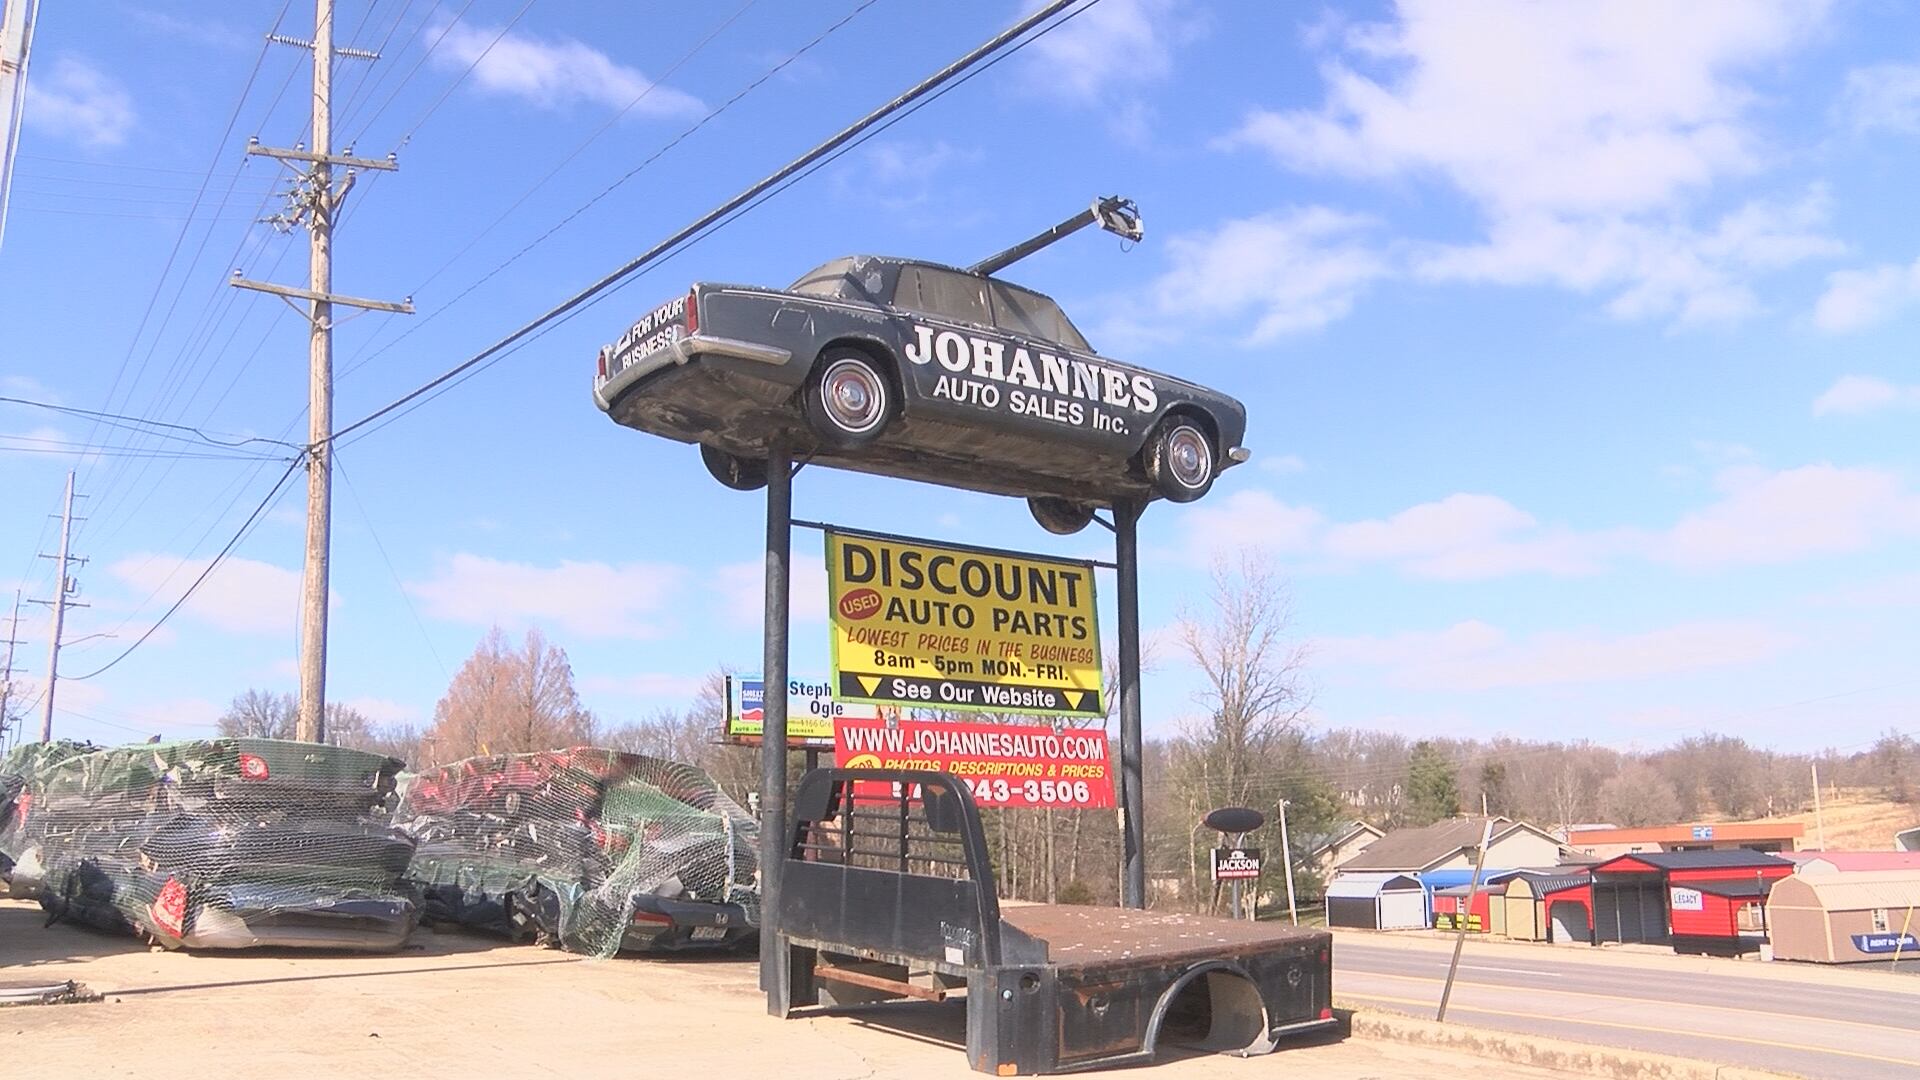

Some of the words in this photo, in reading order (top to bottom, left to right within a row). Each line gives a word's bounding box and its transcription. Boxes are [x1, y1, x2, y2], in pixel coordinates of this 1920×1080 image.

[632, 316, 652, 343] FOR
[653, 297, 684, 327] YOUR
[622, 326, 674, 370] BUSINESS
[905, 325, 1158, 413] JOHANNES
[933, 375, 1000, 408] AUTO
[1009, 390, 1084, 425] SALES
[1093, 407, 1129, 435] Inc.
[842, 543, 1082, 608] DISCOUNT
[843, 594, 880, 615] USED
[885, 597, 975, 629] AUTO
[992, 608, 1088, 640] PARTS
[848, 626, 910, 648] LOWEST
[918, 632, 969, 654] PRICES
[976, 639, 991, 656] IN
[998, 642, 1022, 658] THE
[1031, 646, 1093, 664] BUSINESS
[874, 650, 915, 669] 8am
[935, 655, 973, 676] 5pm
[789, 681, 832, 700] Steph
[892, 678, 932, 700] See
[939, 683, 974, 703] Our
[981, 685, 1056, 709] Website
[810, 700, 843, 718] Ogle
[842, 727, 1104, 760] WWW.JOHANNESAUTO.COM
[884, 759, 941, 772] PHOTOS
[948, 760, 1043, 776] DESCRIPTIONS
[1047, 764, 1056, 776] &
[1061, 765, 1104, 778] PRICES
[1217, 859, 1259, 871] JACKSON
